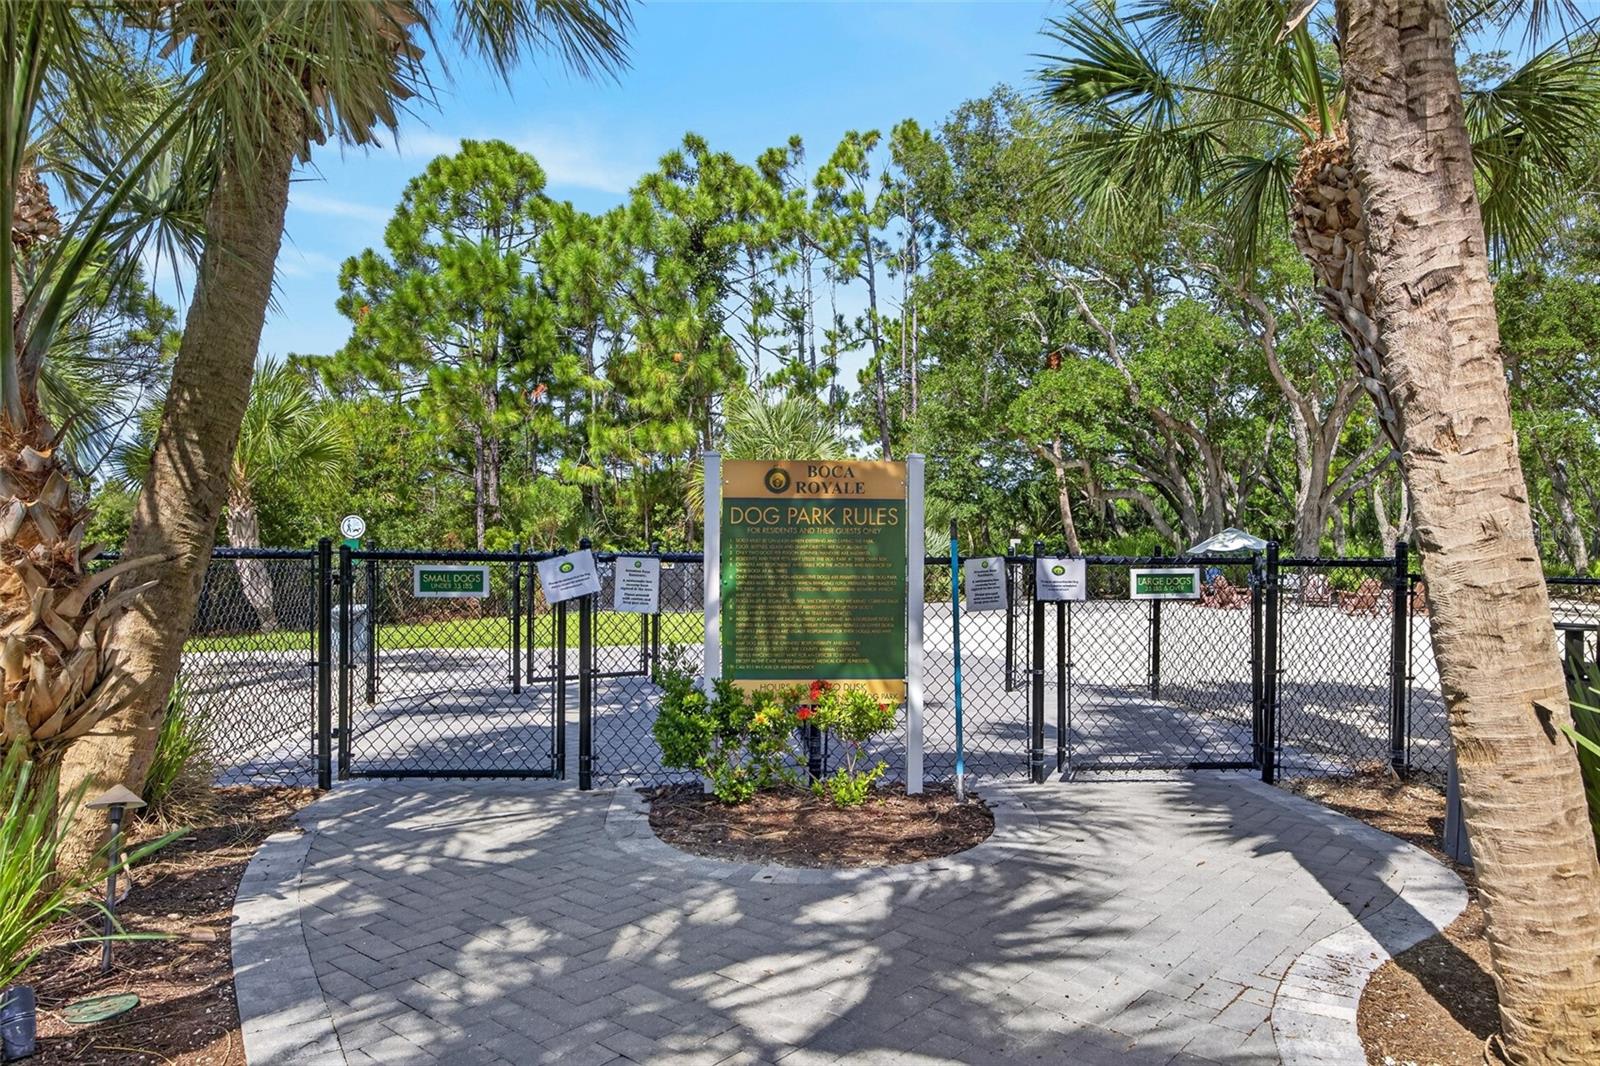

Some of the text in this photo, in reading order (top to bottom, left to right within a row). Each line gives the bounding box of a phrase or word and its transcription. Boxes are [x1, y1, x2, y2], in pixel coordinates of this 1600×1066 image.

[807, 465, 855, 478] BOCA
[796, 481, 865, 494] ROYALE
[730, 506, 898, 526] DOG PARK RULES
[747, 527, 882, 535] FOR RESIDENTS AND THEIR GUESTS ONLY
[423, 574, 481, 583] SMALL DOGS
[1137, 576, 1192, 586] LARGE DOGS
[843, 683, 867, 692] DUSK
[880, 691, 898, 700] PARK
